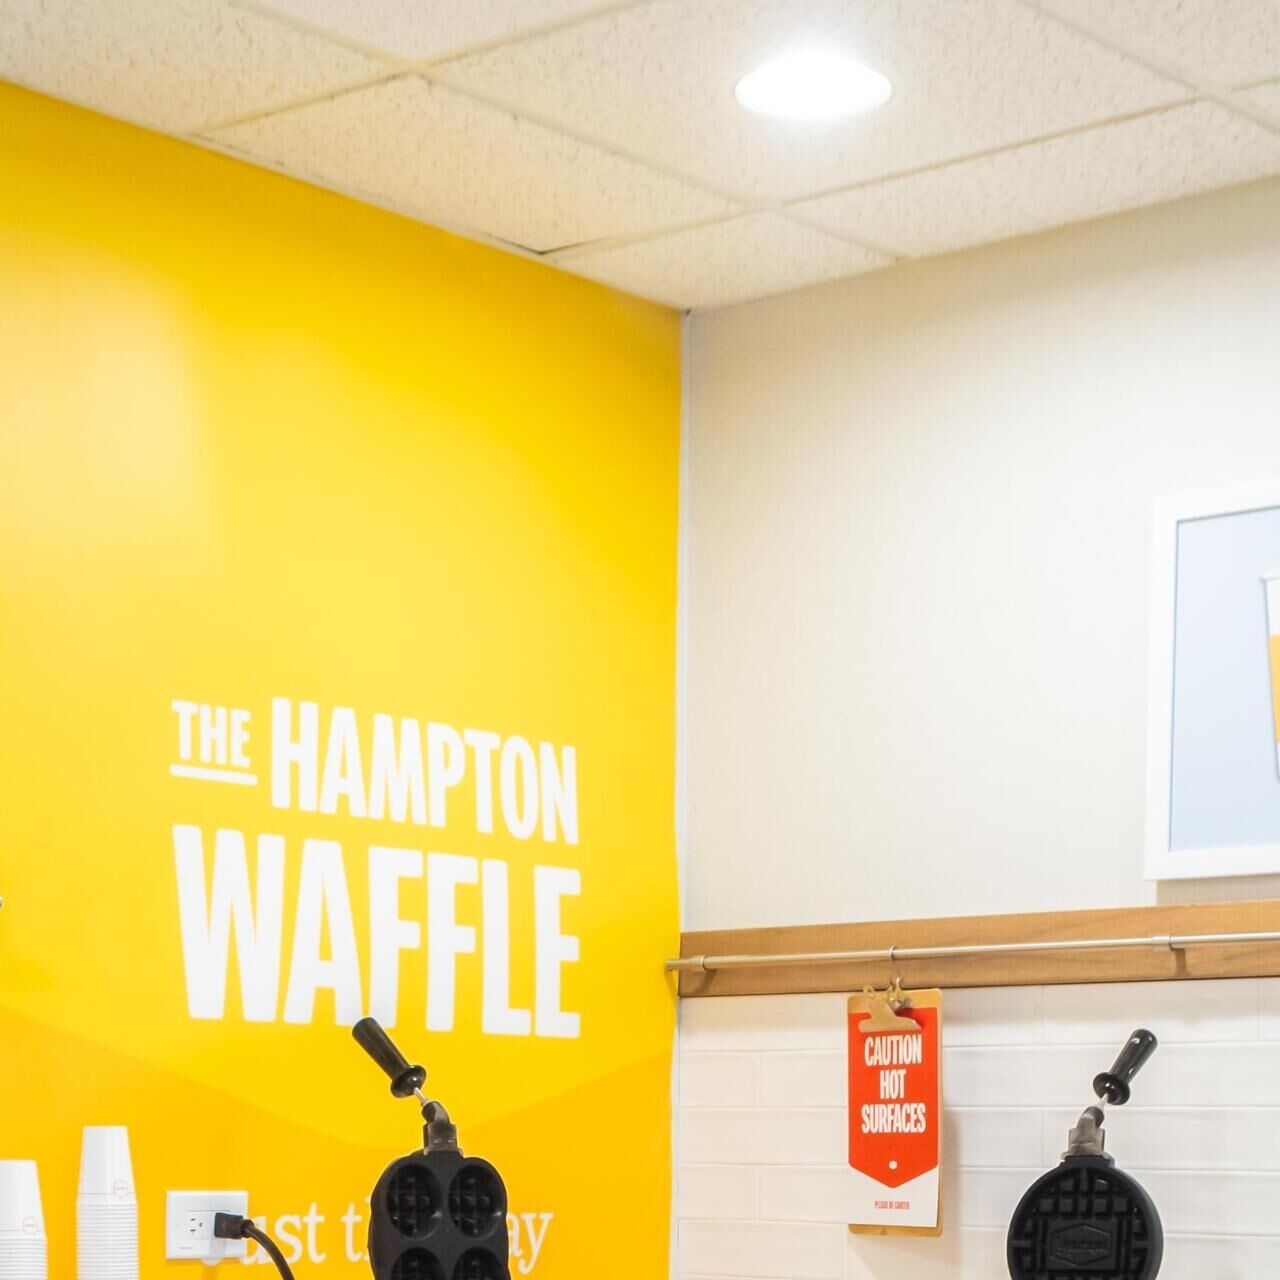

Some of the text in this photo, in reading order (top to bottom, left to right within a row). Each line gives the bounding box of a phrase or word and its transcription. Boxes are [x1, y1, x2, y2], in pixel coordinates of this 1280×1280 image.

[171, 696, 579, 845] THE HAMPTON
[172, 824, 581, 1038] WAFFLE
[864, 1034, 922, 1066] CAUTION
[879, 1069, 906, 1100] HOT
[861, 1103, 926, 1134] SURFACES
[202, 1202, 327, 1265] ust
